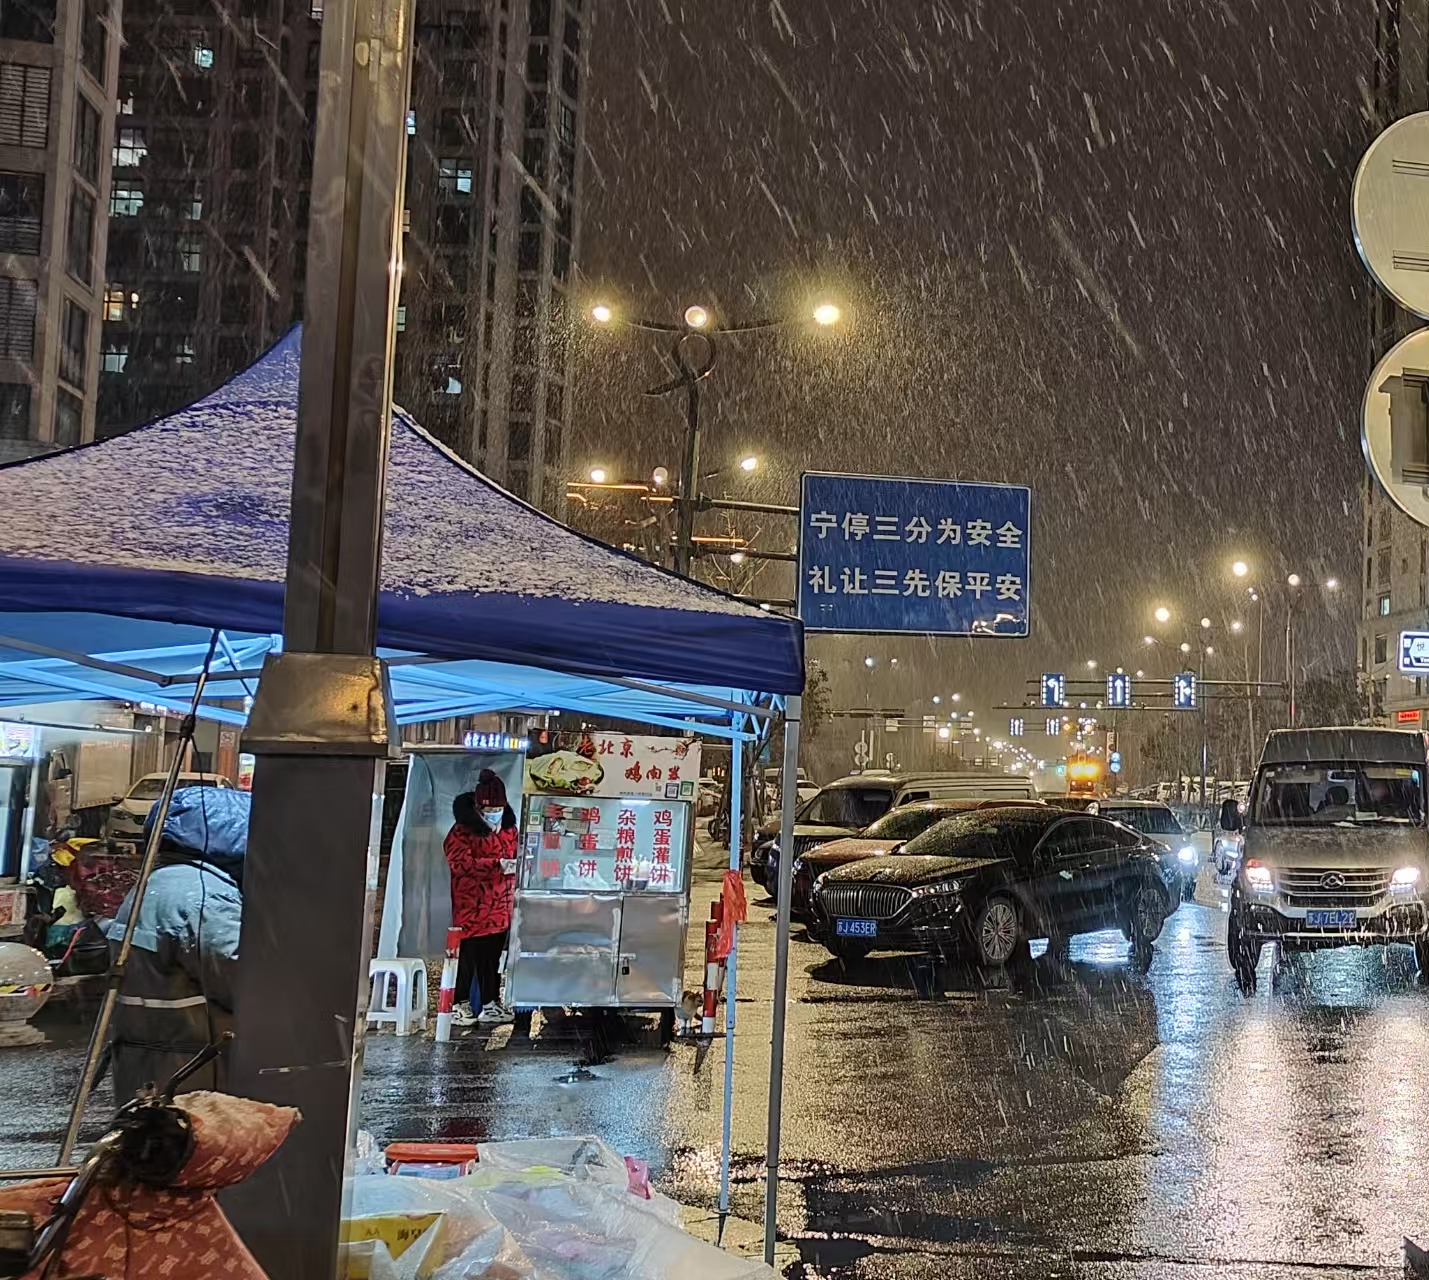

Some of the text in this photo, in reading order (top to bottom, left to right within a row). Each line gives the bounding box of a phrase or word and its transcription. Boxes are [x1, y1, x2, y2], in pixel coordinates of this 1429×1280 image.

[809, 510, 1023, 549] 宁停三分为安全
[808, 566, 1022, 601] 礼让三先保平安
[579, 734, 634, 758] 老北京
[578, 805, 601, 878] 鸡蛋饼
[614, 809, 637, 883] 杂粮煎饼
[649, 810, 673, 884] 鸡蛋灌饼
